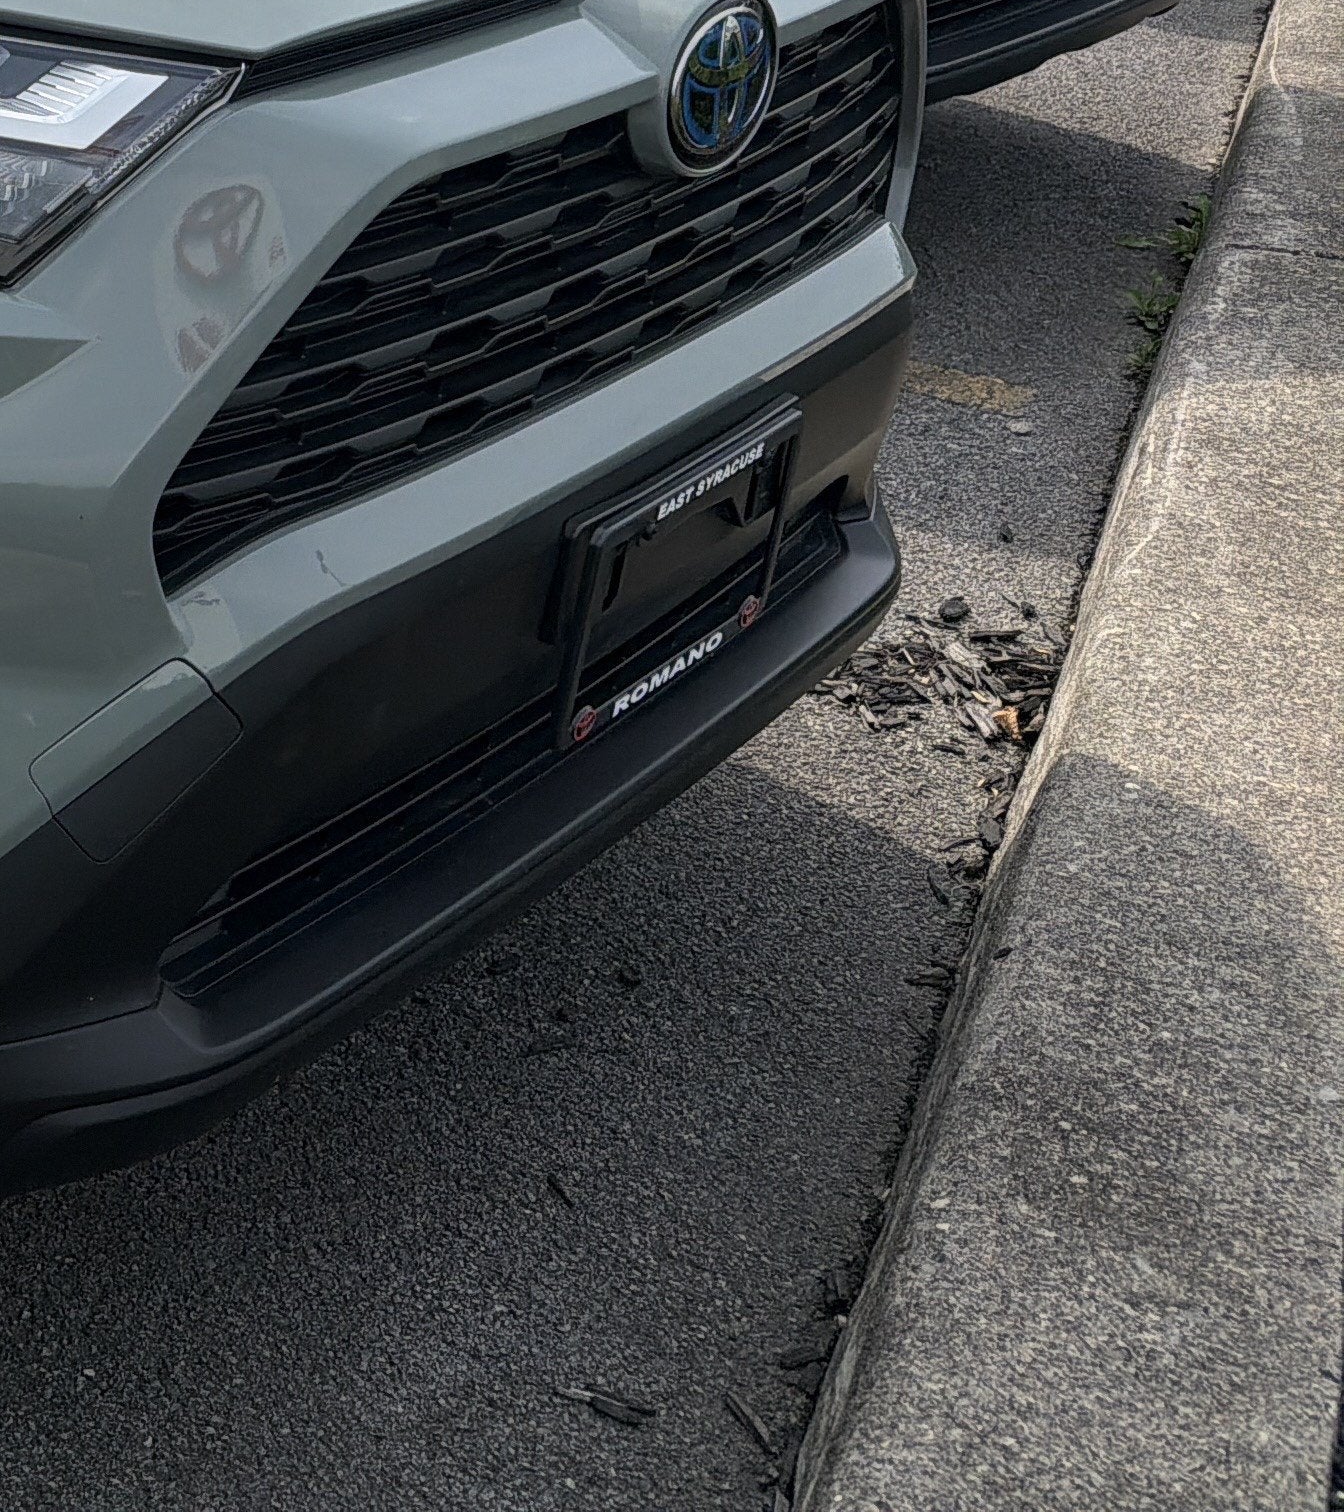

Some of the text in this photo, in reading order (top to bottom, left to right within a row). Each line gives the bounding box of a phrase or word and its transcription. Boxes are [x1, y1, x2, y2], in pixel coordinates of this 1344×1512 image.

[657, 442, 765, 521] EAST SYRACUSE
[612, 631, 723, 719] ROMANO
